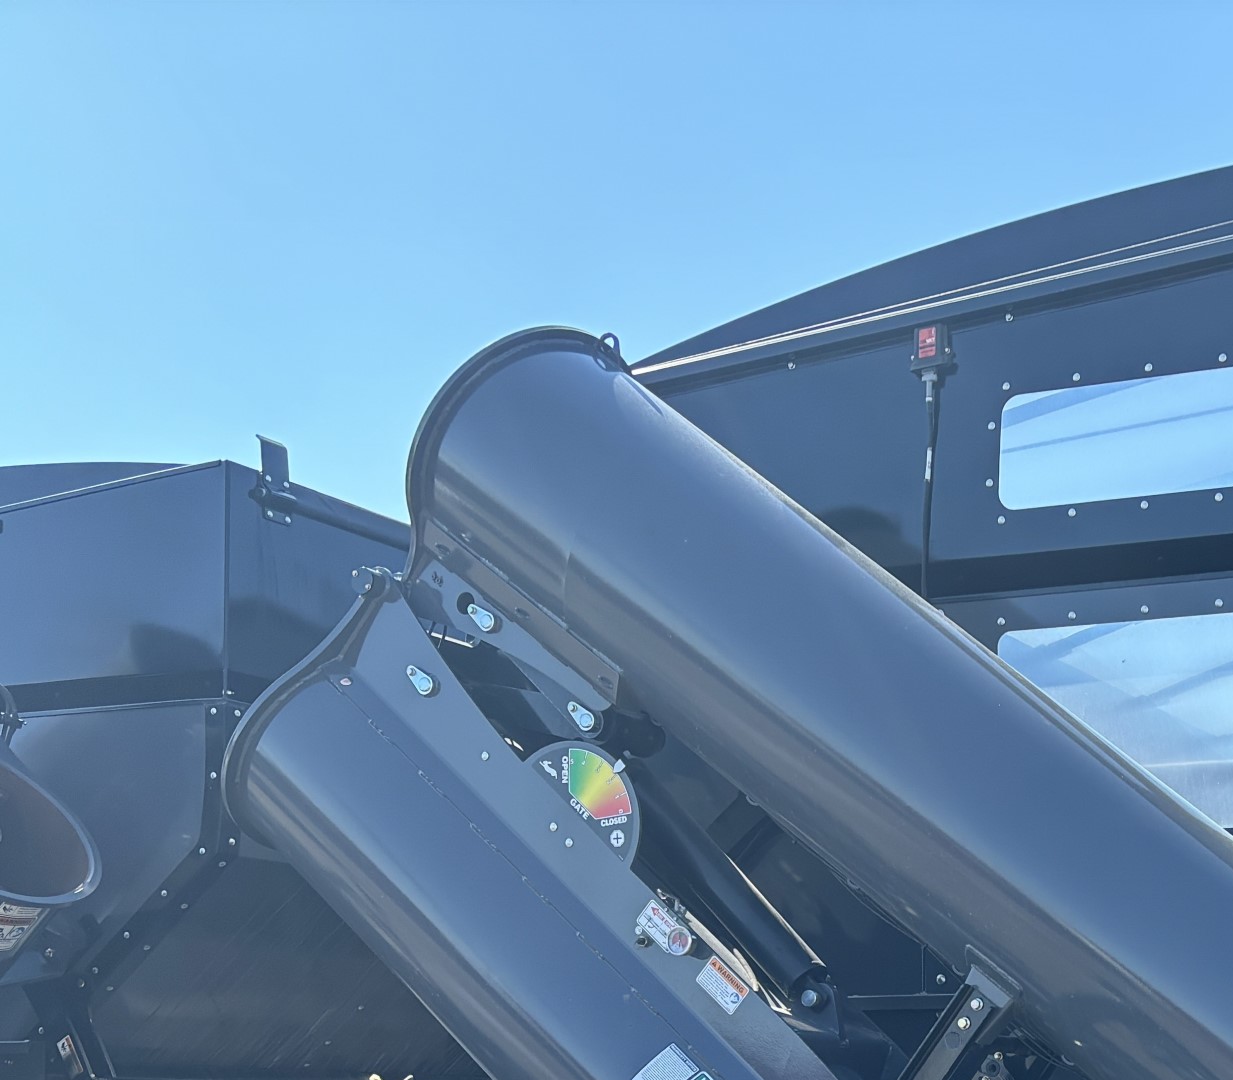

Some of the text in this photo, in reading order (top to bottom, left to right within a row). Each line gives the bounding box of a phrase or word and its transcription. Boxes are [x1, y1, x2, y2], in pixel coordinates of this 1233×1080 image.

[570, 798, 590, 820] GATE
[600, 816, 628, 826] CLOSED
[717, 966, 744, 994] WARNING
